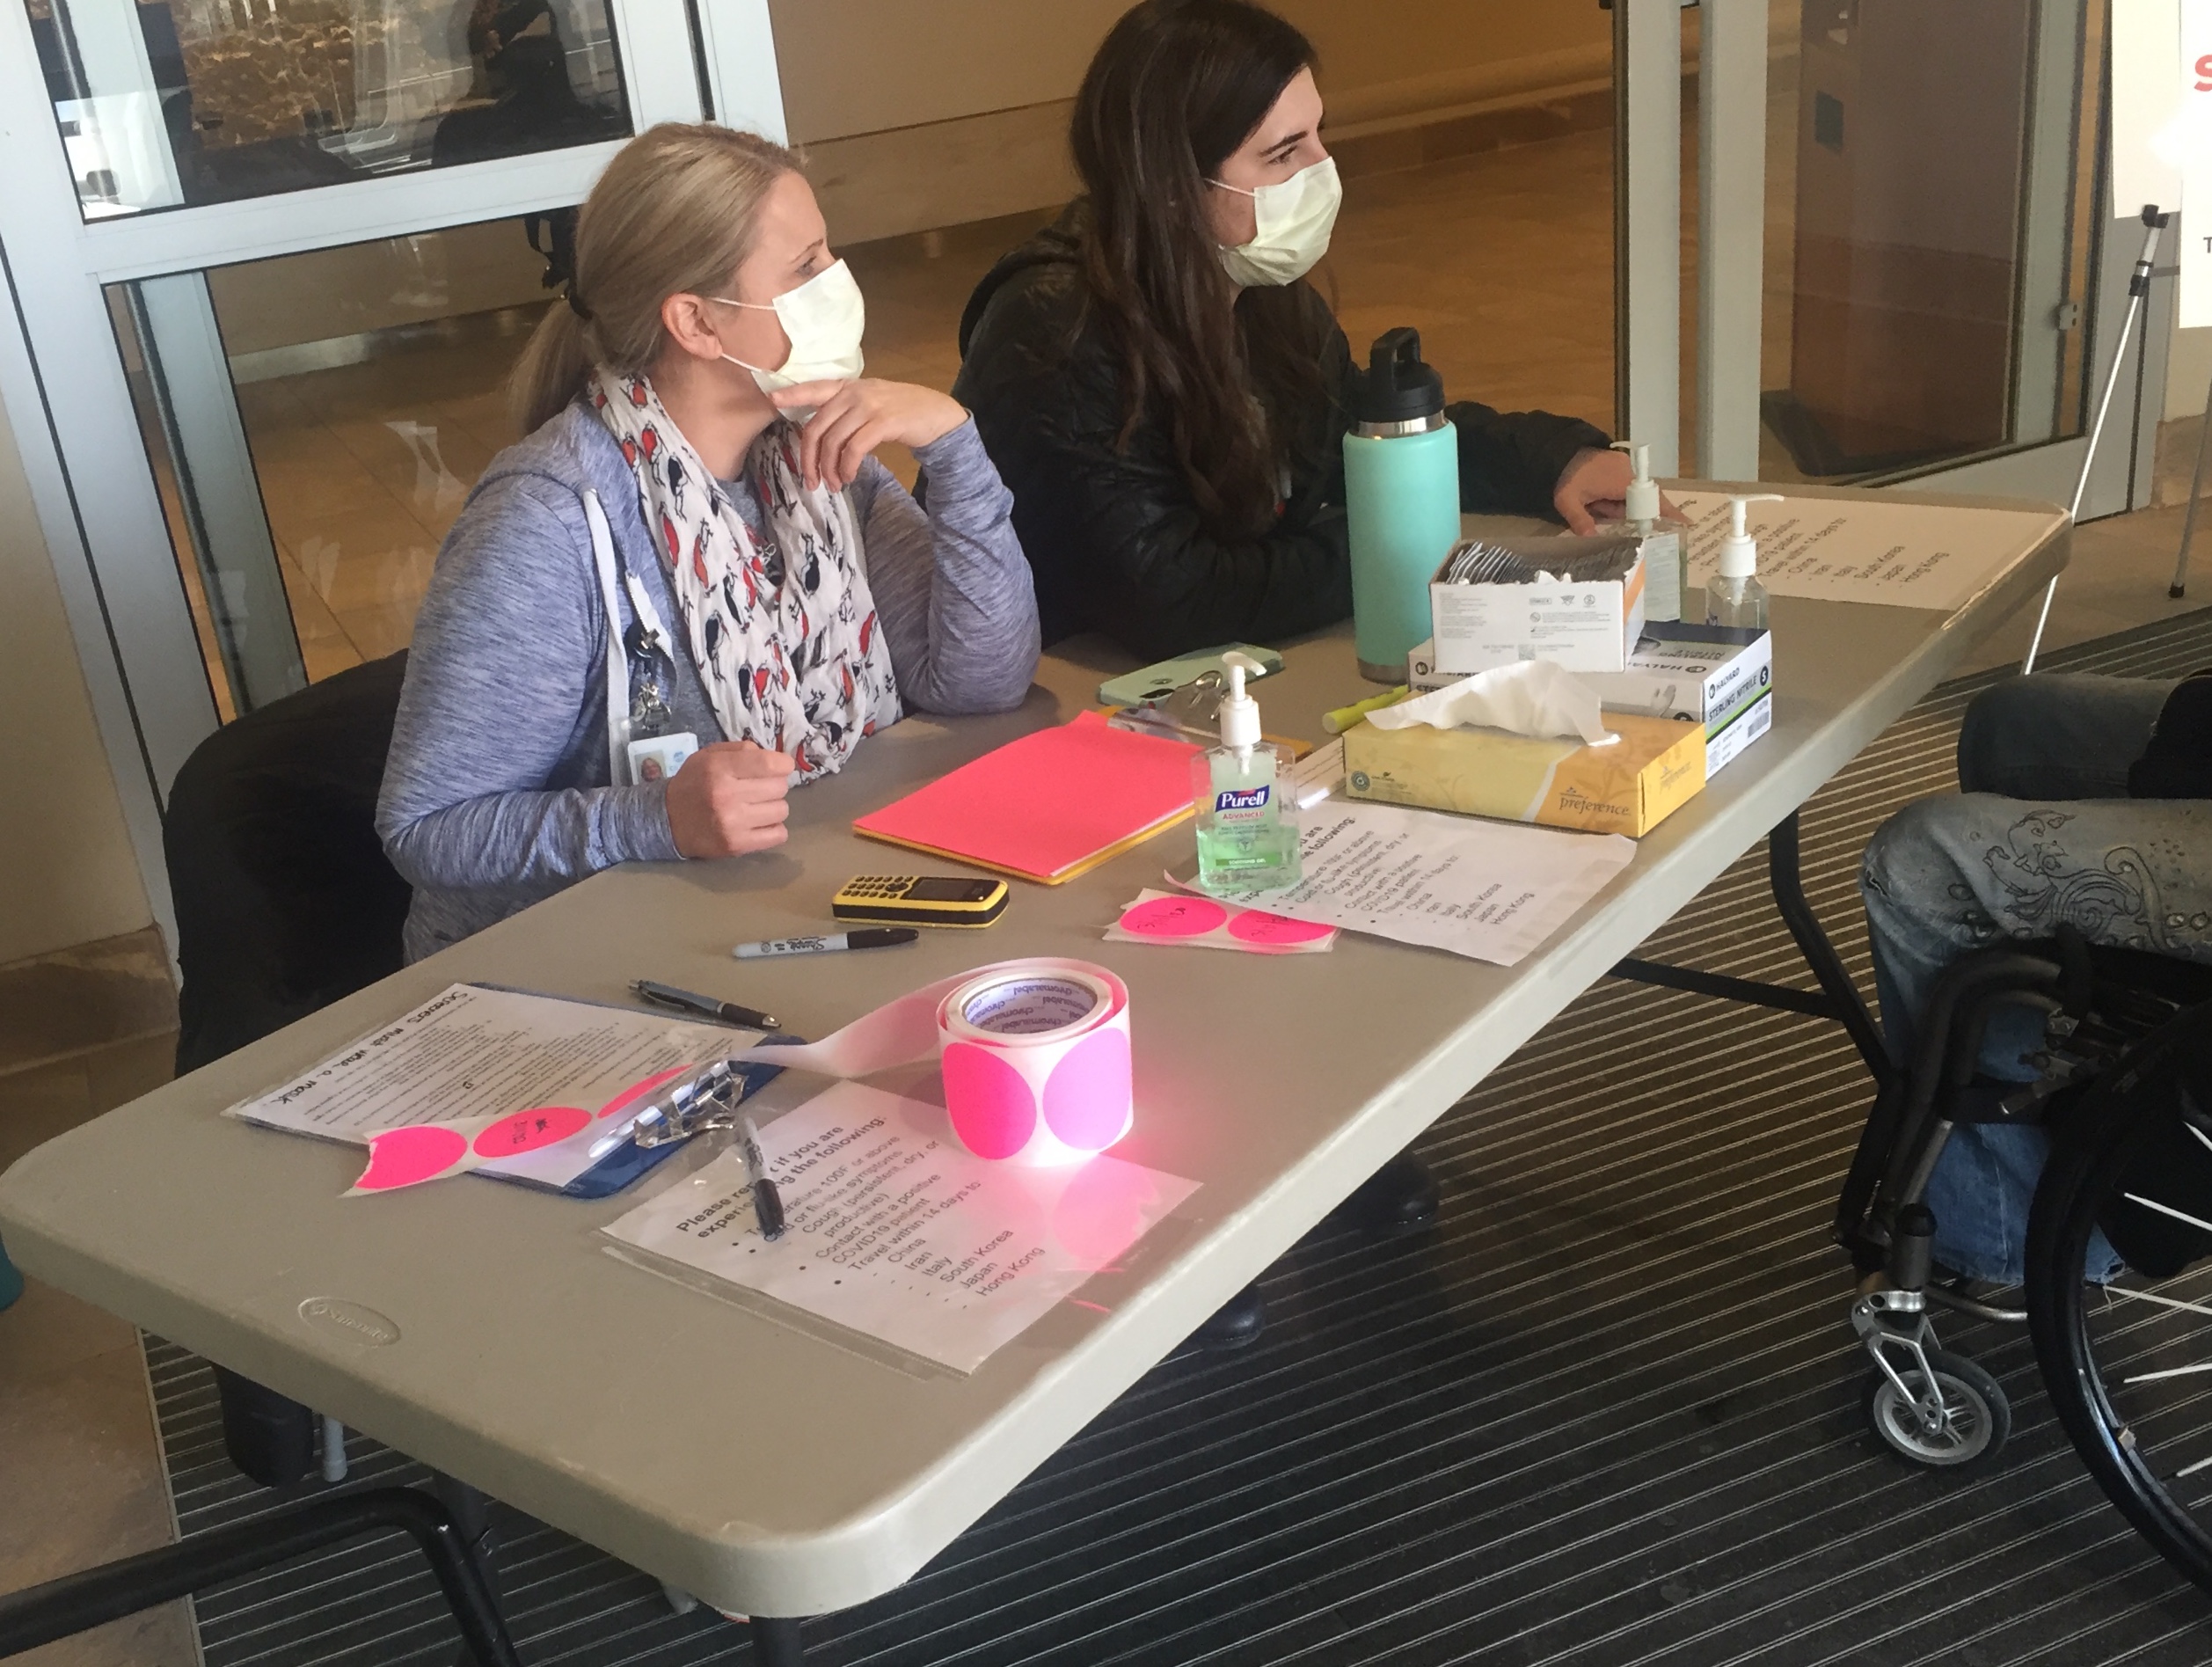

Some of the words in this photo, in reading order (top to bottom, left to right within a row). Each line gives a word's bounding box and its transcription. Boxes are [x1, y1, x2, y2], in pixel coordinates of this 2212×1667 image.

[1628, 662, 1683, 670] HALYA
[1709, 693, 1735, 722] STERLING
[1736, 675, 1757, 700] NITRILE
[1221, 791, 1266, 808] Purell
[1559, 795, 1632, 815] preference
[1223, 811, 1265, 821] ADVANCED
[1304, 826, 1325, 837] are
[1488, 908, 1518, 925] Hong
[1508, 893, 1536, 907] Kong
[317, 1069, 332, 1078] a
[787, 1157, 820, 1173] the
[813, 1115, 890, 1159] following:
[816, 1165, 855, 1186] 100F
[862, 1136, 902, 1158] above
[674, 1197, 733, 1231] Please
[771, 1157, 792, 1166] if
[788, 1141, 821, 1158] you
[815, 1126, 844, 1141] are
[792, 1213, 811, 1223] or
[843, 1150, 906, 1187] symptoms
[799, 1206, 846, 1233] Cough
[813, 1226, 865, 1258] Contact
[859, 1210, 888, 1226] with
[892, 1173, 944, 1203] positive
[817, 1192, 892, 1237] productive)
[847, 1243, 892, 1270] Travel
[886, 1219, 926, 1244] within
[921, 1208, 941, 1218] 14
[937, 1189, 972, 1209] days
[829, 1225, 893, 1264] COVID19
[887, 1198, 931, 1225] patient
[885, 1237, 927, 1262] China
[903, 1251, 934, 1269] Iran
[938, 1255, 980, 1282] South
[973, 1230, 1014, 1255] Korea
[920, 1256, 955, 1276] Italy
[955, 1261, 1001, 1290] Japan
[974, 1270, 1017, 1297] Hong
[1006, 1247, 1047, 1271] Kong
